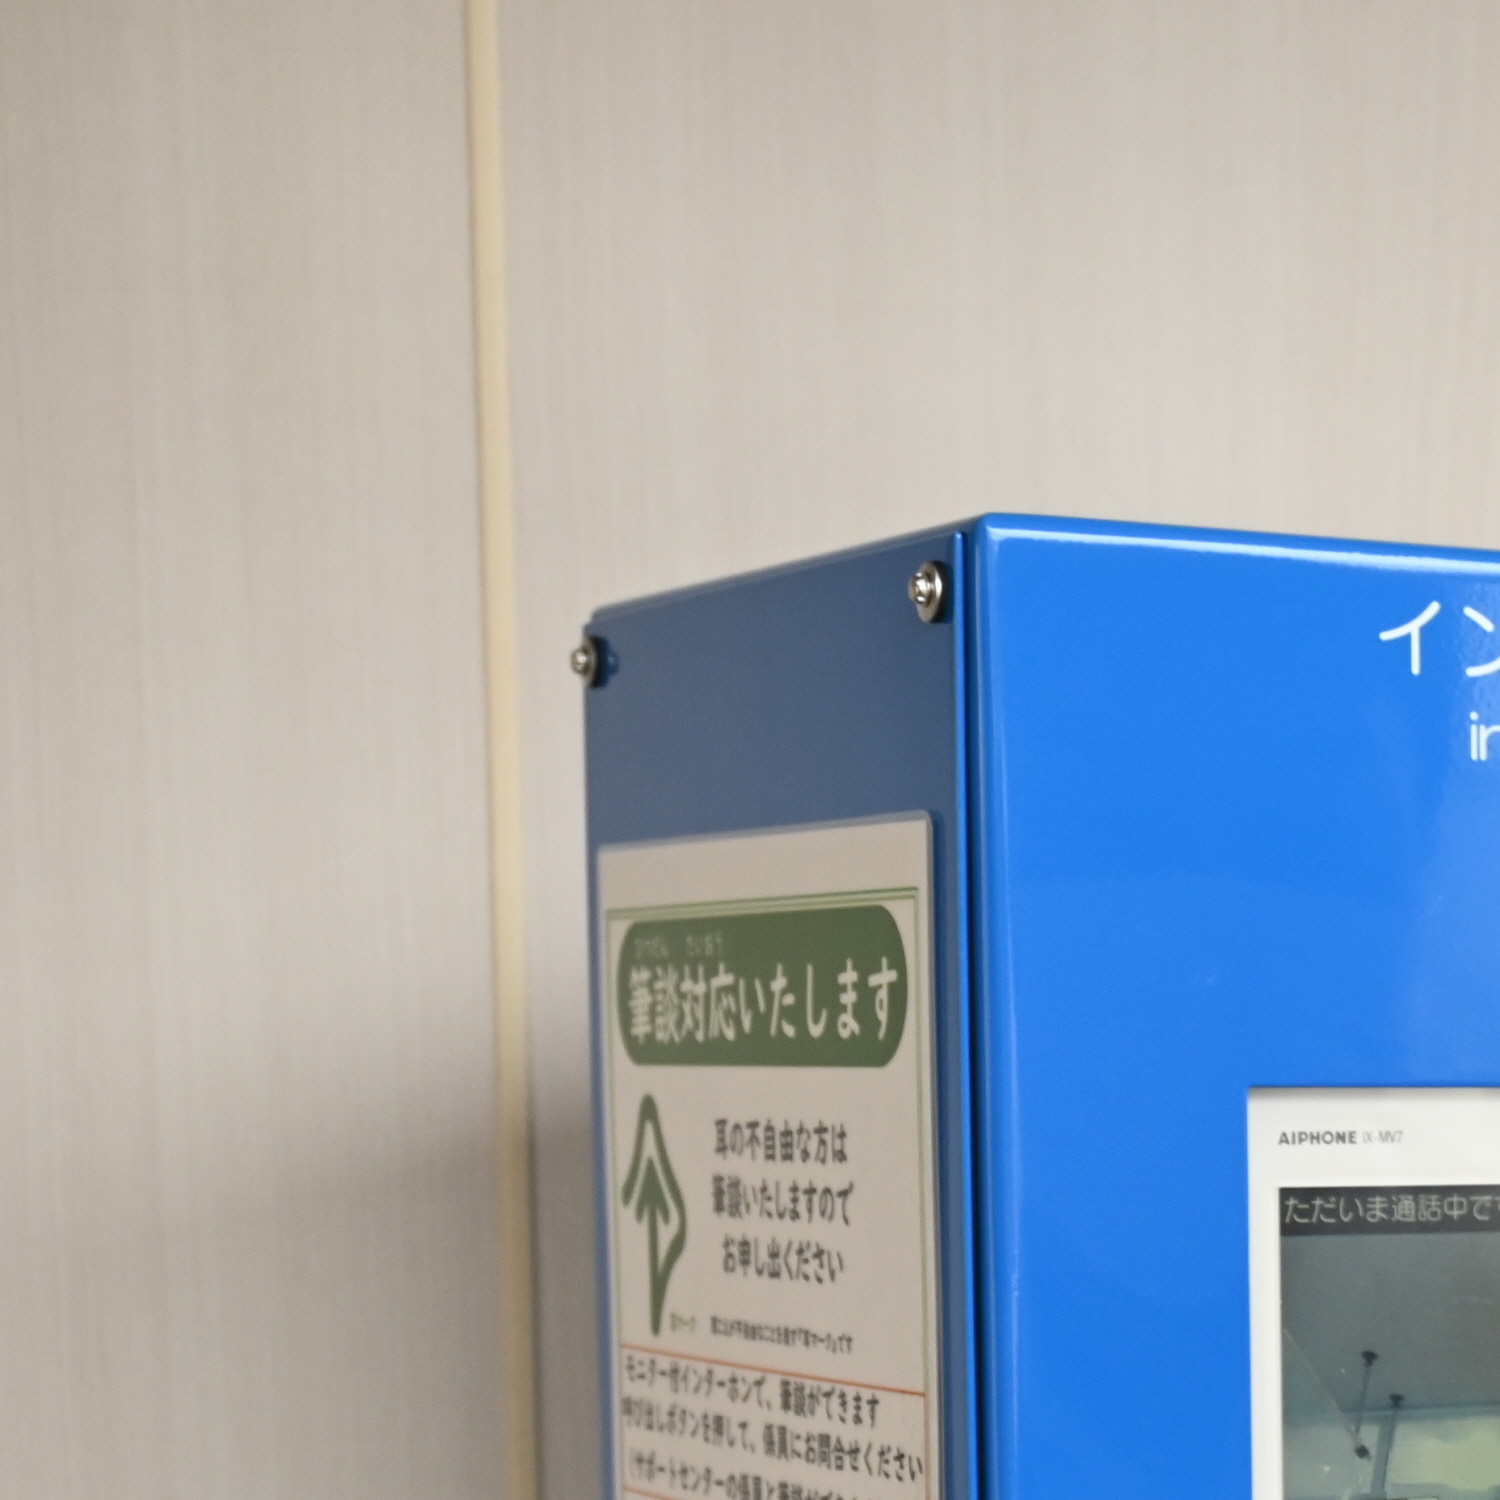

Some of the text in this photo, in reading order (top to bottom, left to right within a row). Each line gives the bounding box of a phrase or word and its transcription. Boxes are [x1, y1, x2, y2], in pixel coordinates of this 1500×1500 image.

[628, 957, 898, 1045] 筆談対応いたします
[713, 1118, 848, 1165] 耳の不自由な方は
[1278, 1130, 1358, 1145] AIPHONE
[711, 1176, 854, 1226] 筆談いたしますので
[722, 1236, 843, 1284] お申し出ください
